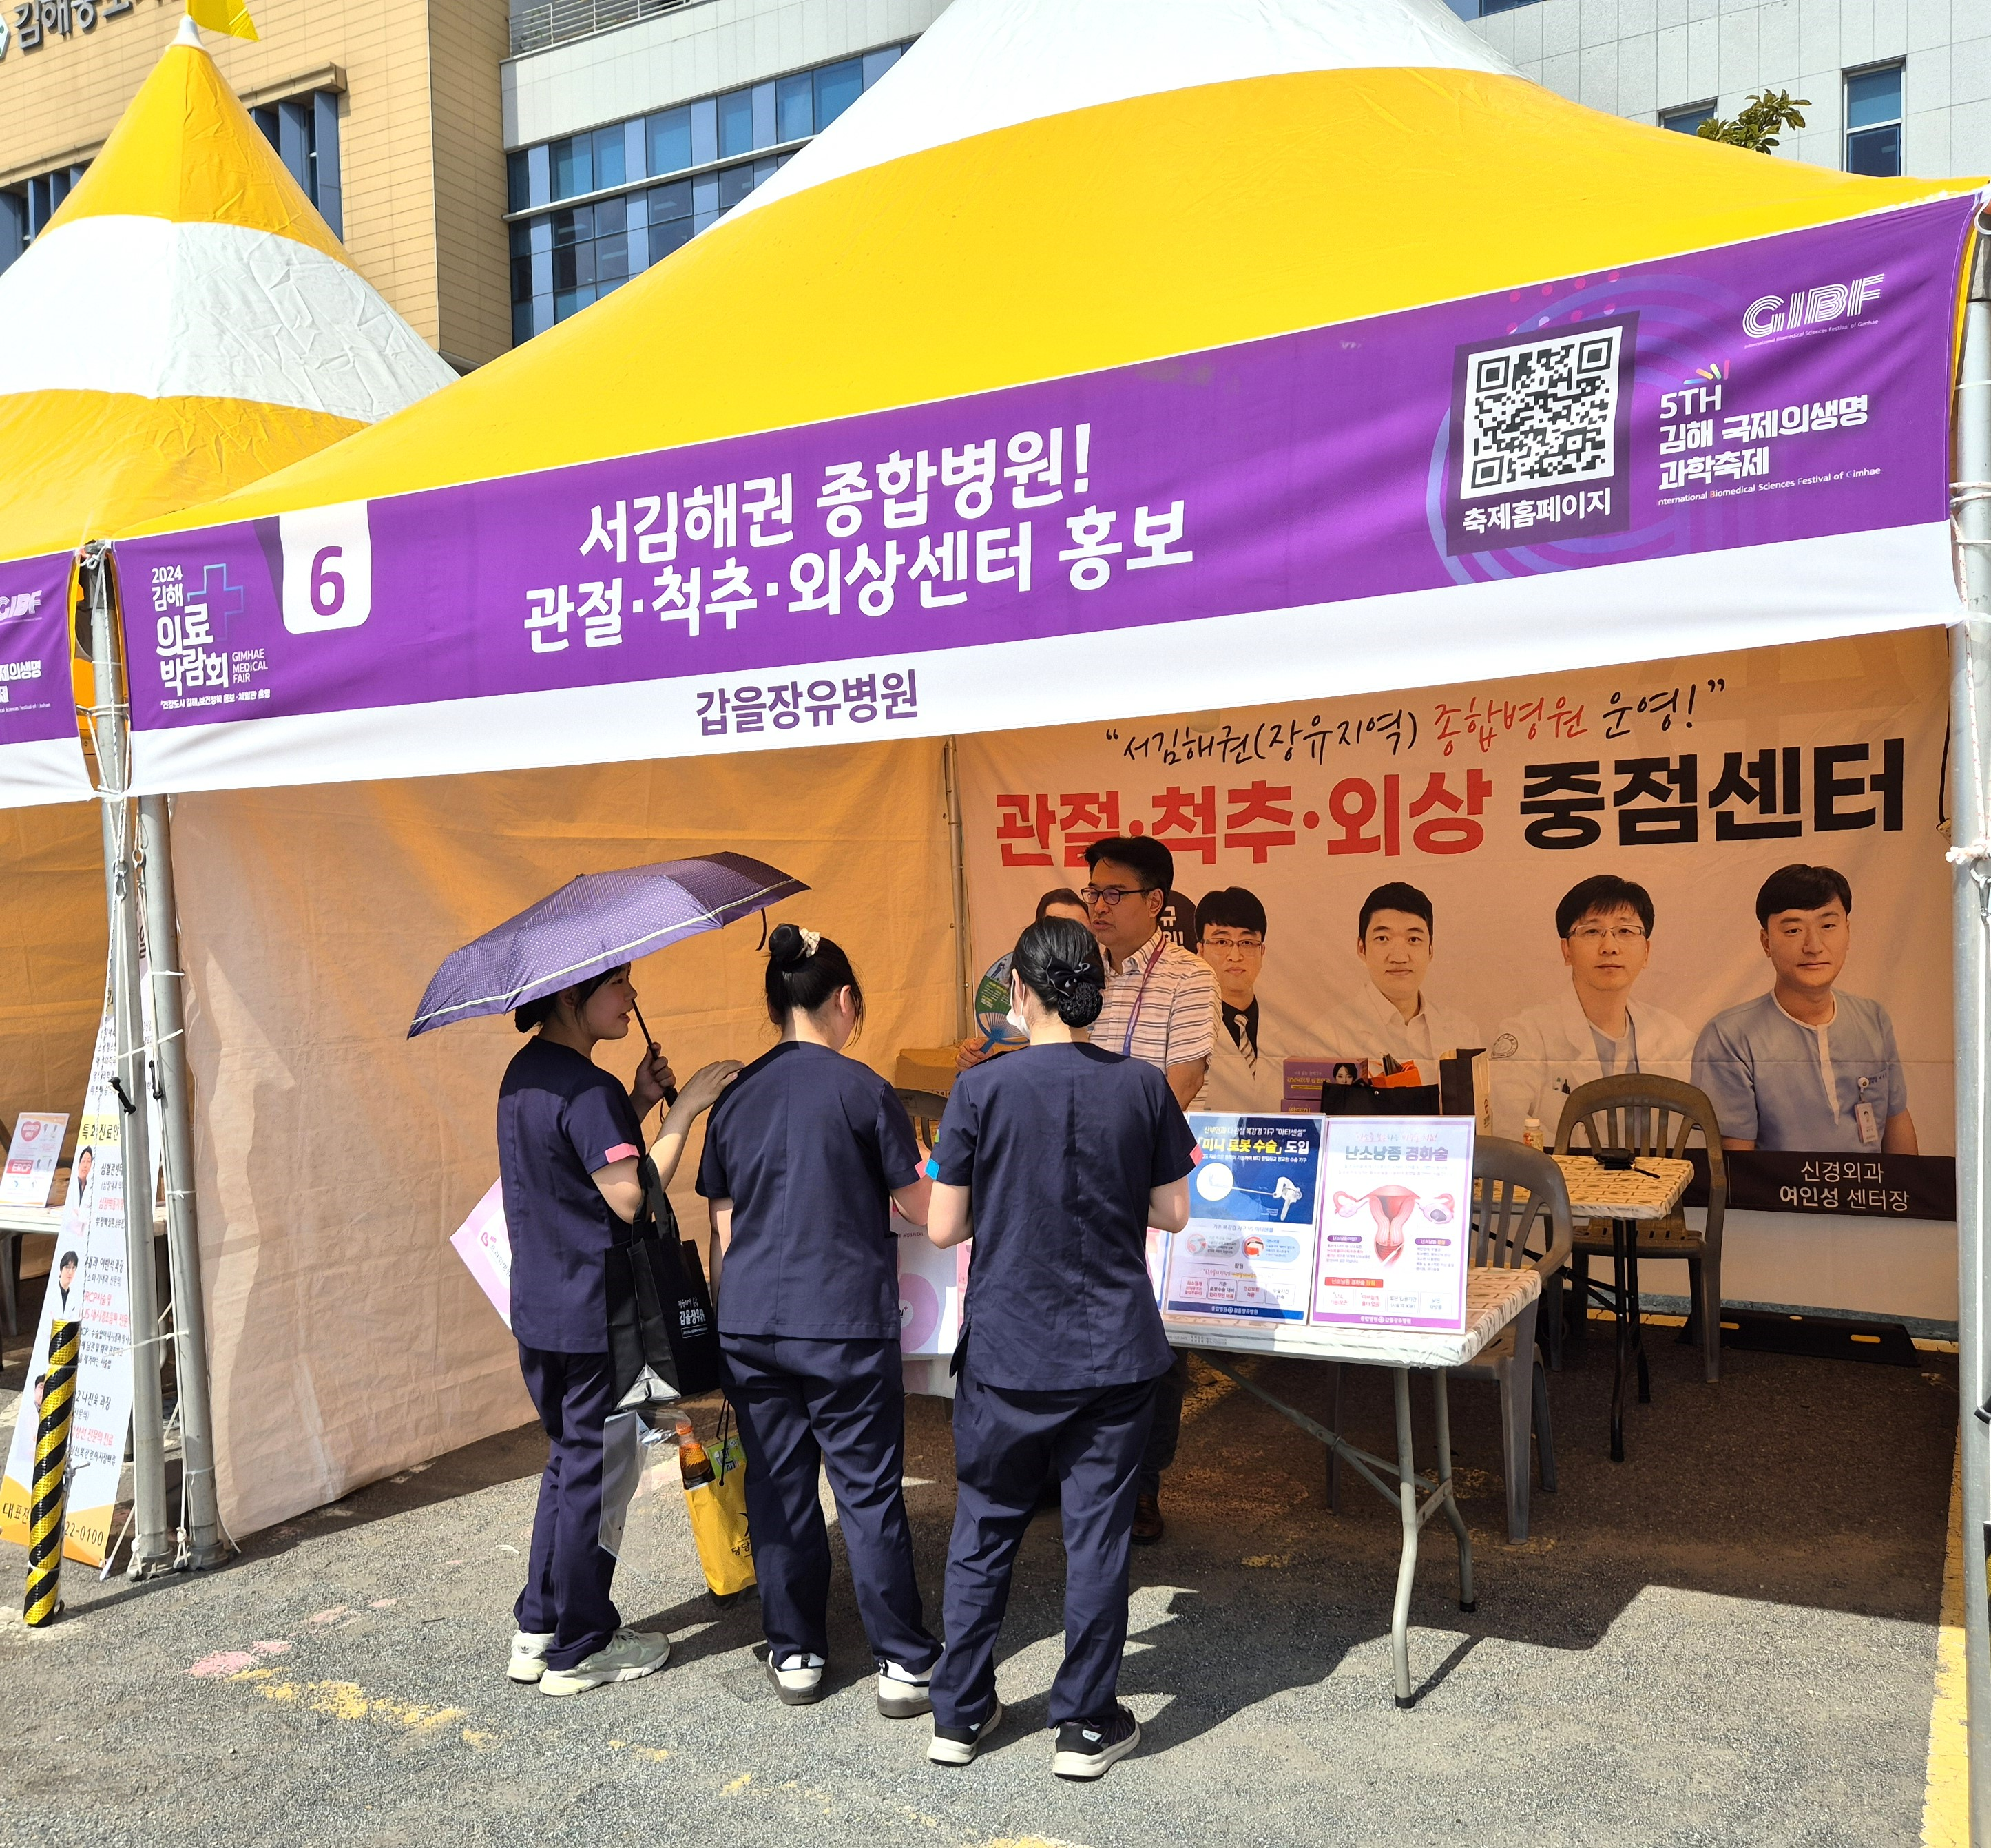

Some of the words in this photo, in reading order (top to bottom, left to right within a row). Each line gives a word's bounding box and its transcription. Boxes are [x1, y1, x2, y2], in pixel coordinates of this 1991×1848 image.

[1742, 273, 1885, 338] GIBF
[1660, 384, 1722, 419] 5TH
[1660, 419, 1713, 455] 김해
[1722, 394, 1868, 443] 국제의생명
[1659, 446, 1769, 490] 과학축제
[1710, 485, 1755, 499] Biomedical
[1758, 481, 1795, 491] Sciences
[1797, 473, 1831, 485] Festival
[1833, 472, 1844, 480] of
[578, 473, 795, 565] 서김해권
[815, 422, 1091, 538] 종합병원!
[1463, 487, 1611, 534] 축제홈페이지
[152, 565, 183, 583] 2024
[311, 546, 345, 616] 6
[524, 521, 1032, 654] 관절·척추·외상센터
[1059, 500, 1193, 591] 홍보
[152, 583, 183, 612] 김해
[156, 603, 214, 656] 의료
[160, 647, 229, 696] 박람회
[232, 648, 264, 661] GIMHAE
[233, 673, 250, 683] FAIR
[696, 669, 918, 736] 갑을장유병원
[1433, 697, 1588, 756] 종합병원
[996, 768, 1492, 867] 관절·척추·외상
[1520, 738, 1905, 850] 중점센터
[1227, 1139, 1251, 1153] 로봇
[1284, 1140, 1309, 1155] 도입
[1264, 1128, 1275, 1136] 기구
[1346, 1145, 1401, 1161] 난소낭종
[1406, 1146, 1449, 1162] 경화술
[1800, 1161, 1884, 1183] 신경외과
[1780, 1185, 1839, 1209] 여인성
[1846, 1188, 1910, 1212] 센터장
